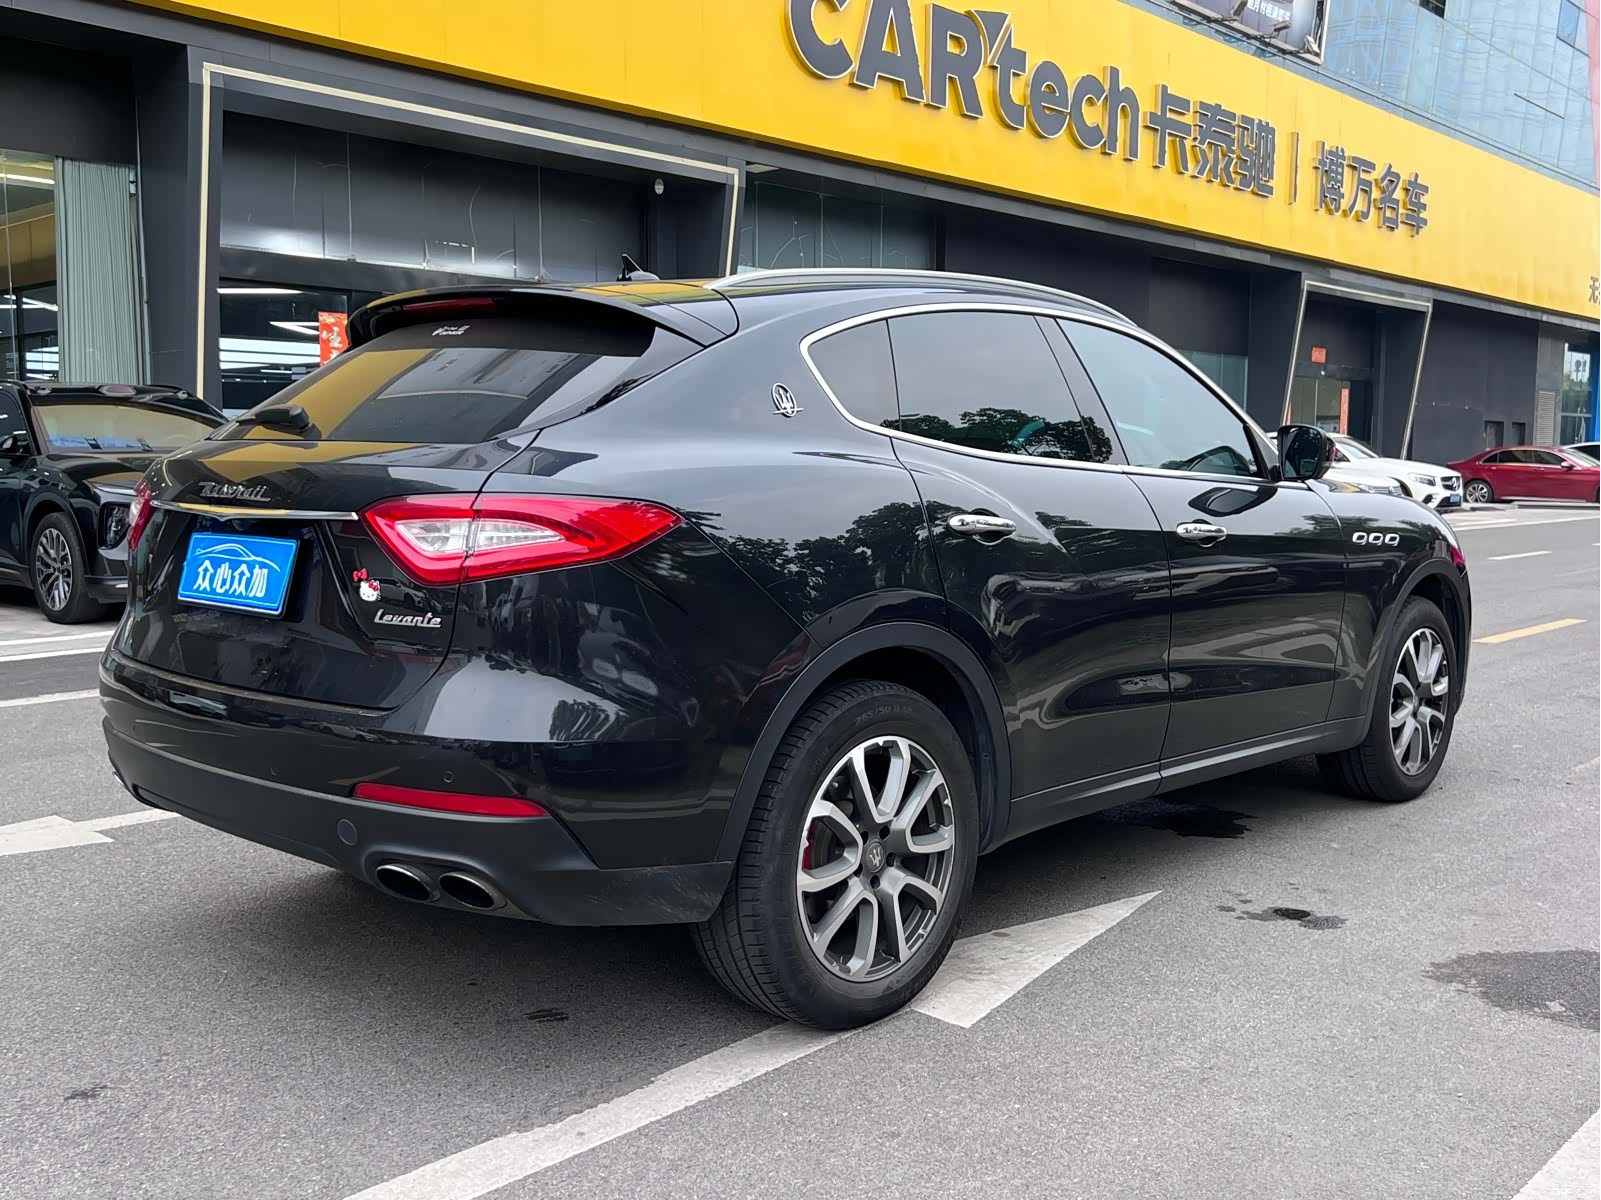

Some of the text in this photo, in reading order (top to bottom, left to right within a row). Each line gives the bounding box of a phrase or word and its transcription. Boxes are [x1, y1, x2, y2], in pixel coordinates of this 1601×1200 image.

[786, 0, 1430, 238] CARtech 卡泰驰 博万名车
[192, 559, 269, 598] 众心众加
[374, 608, 442, 628] Levante
